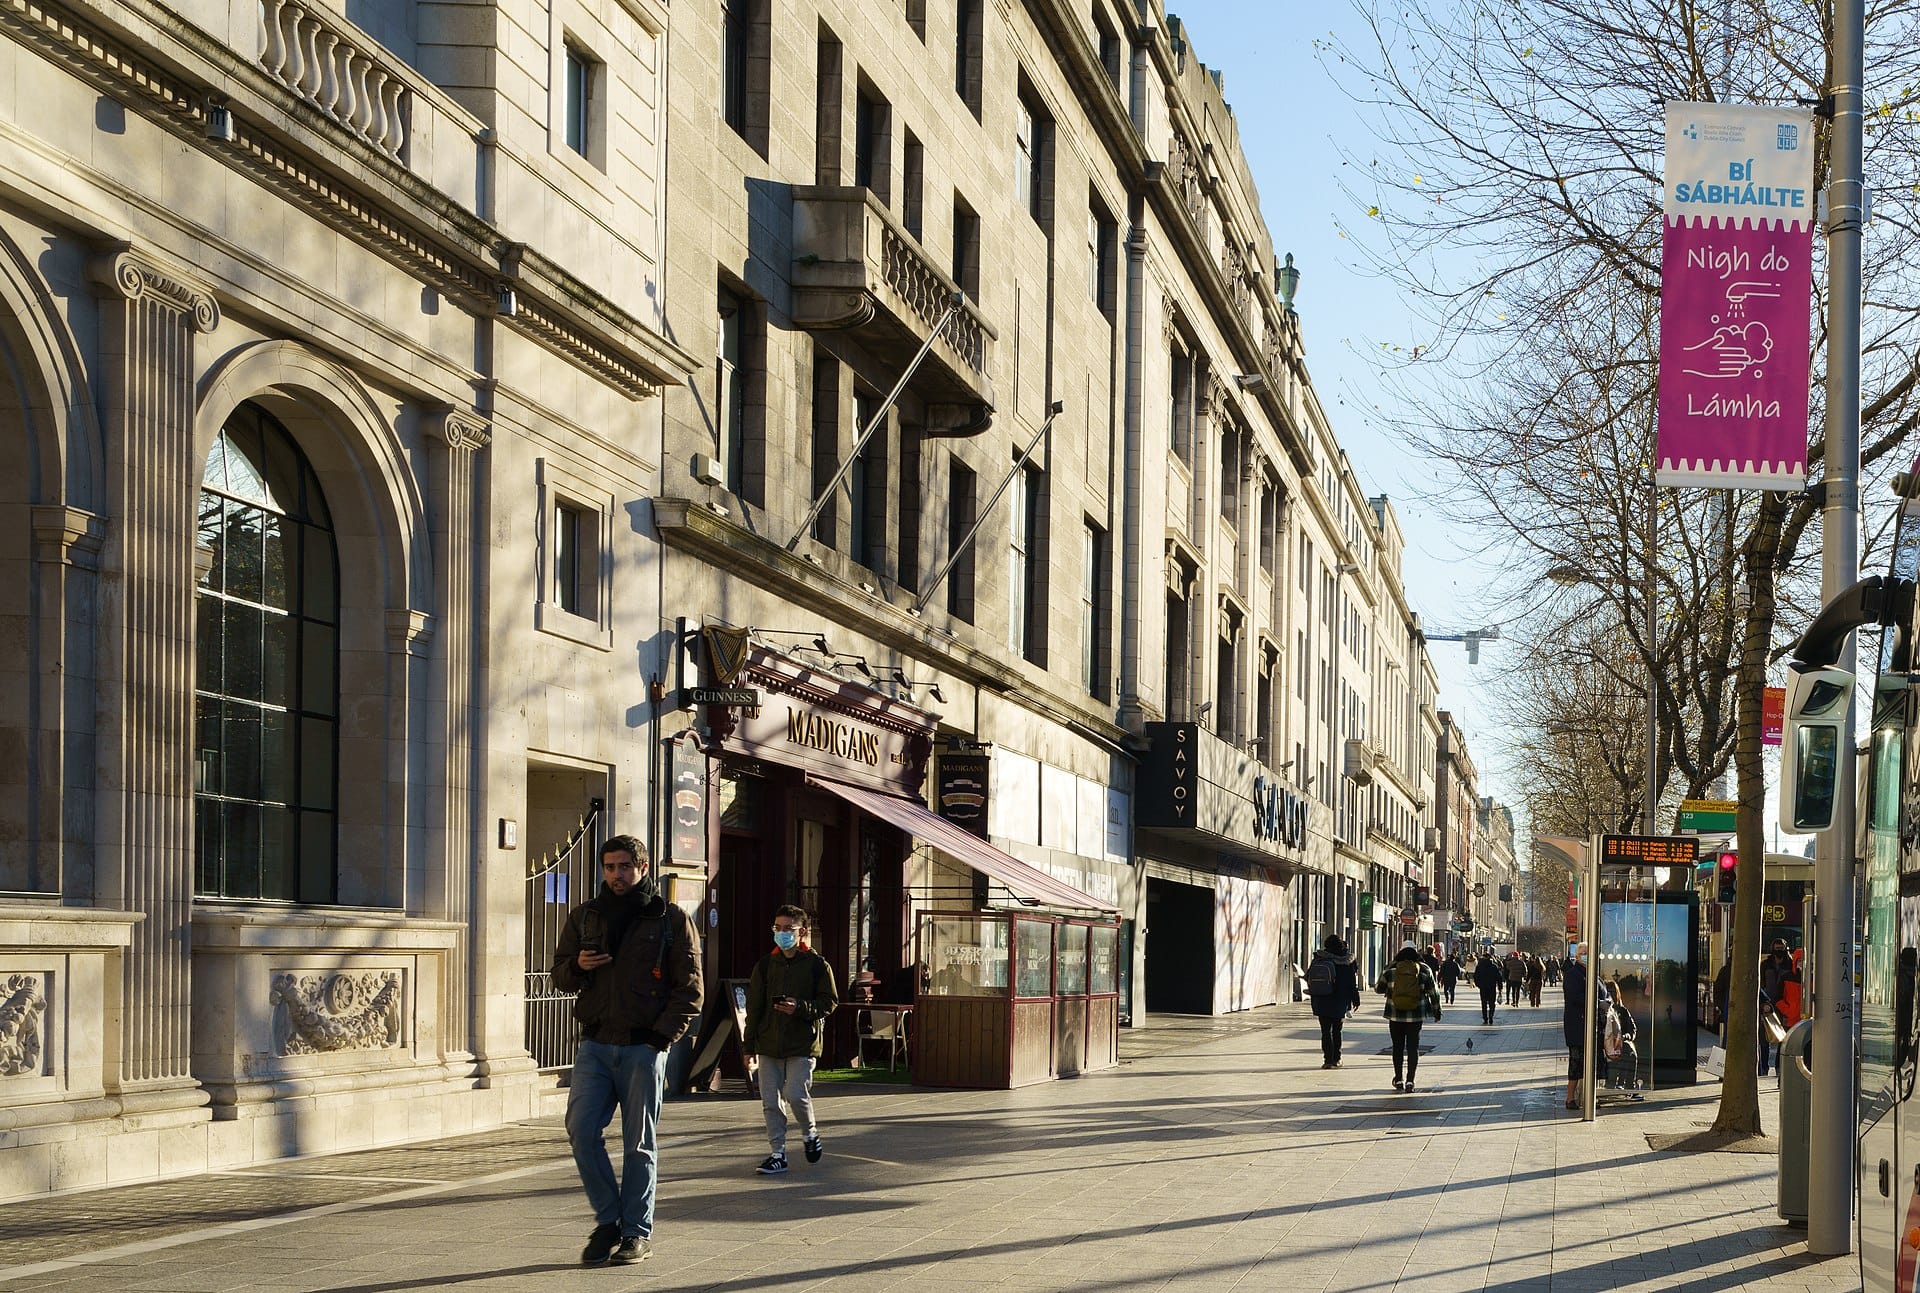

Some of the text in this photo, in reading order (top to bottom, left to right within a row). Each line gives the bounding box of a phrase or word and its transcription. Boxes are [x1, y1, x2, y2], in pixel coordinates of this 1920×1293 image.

[1730, 159, 1754, 180] BÍ
[1676, 180, 1804, 207] SÁBHÁILTE
[1688, 245, 1789, 279] Nigh do
[1688, 393, 1780, 418] Lámha
[692, 689, 752, 702] GUINNESS
[786, 706, 879, 766] MADIGANS
[1174, 730, 1186, 818] SAVOY
